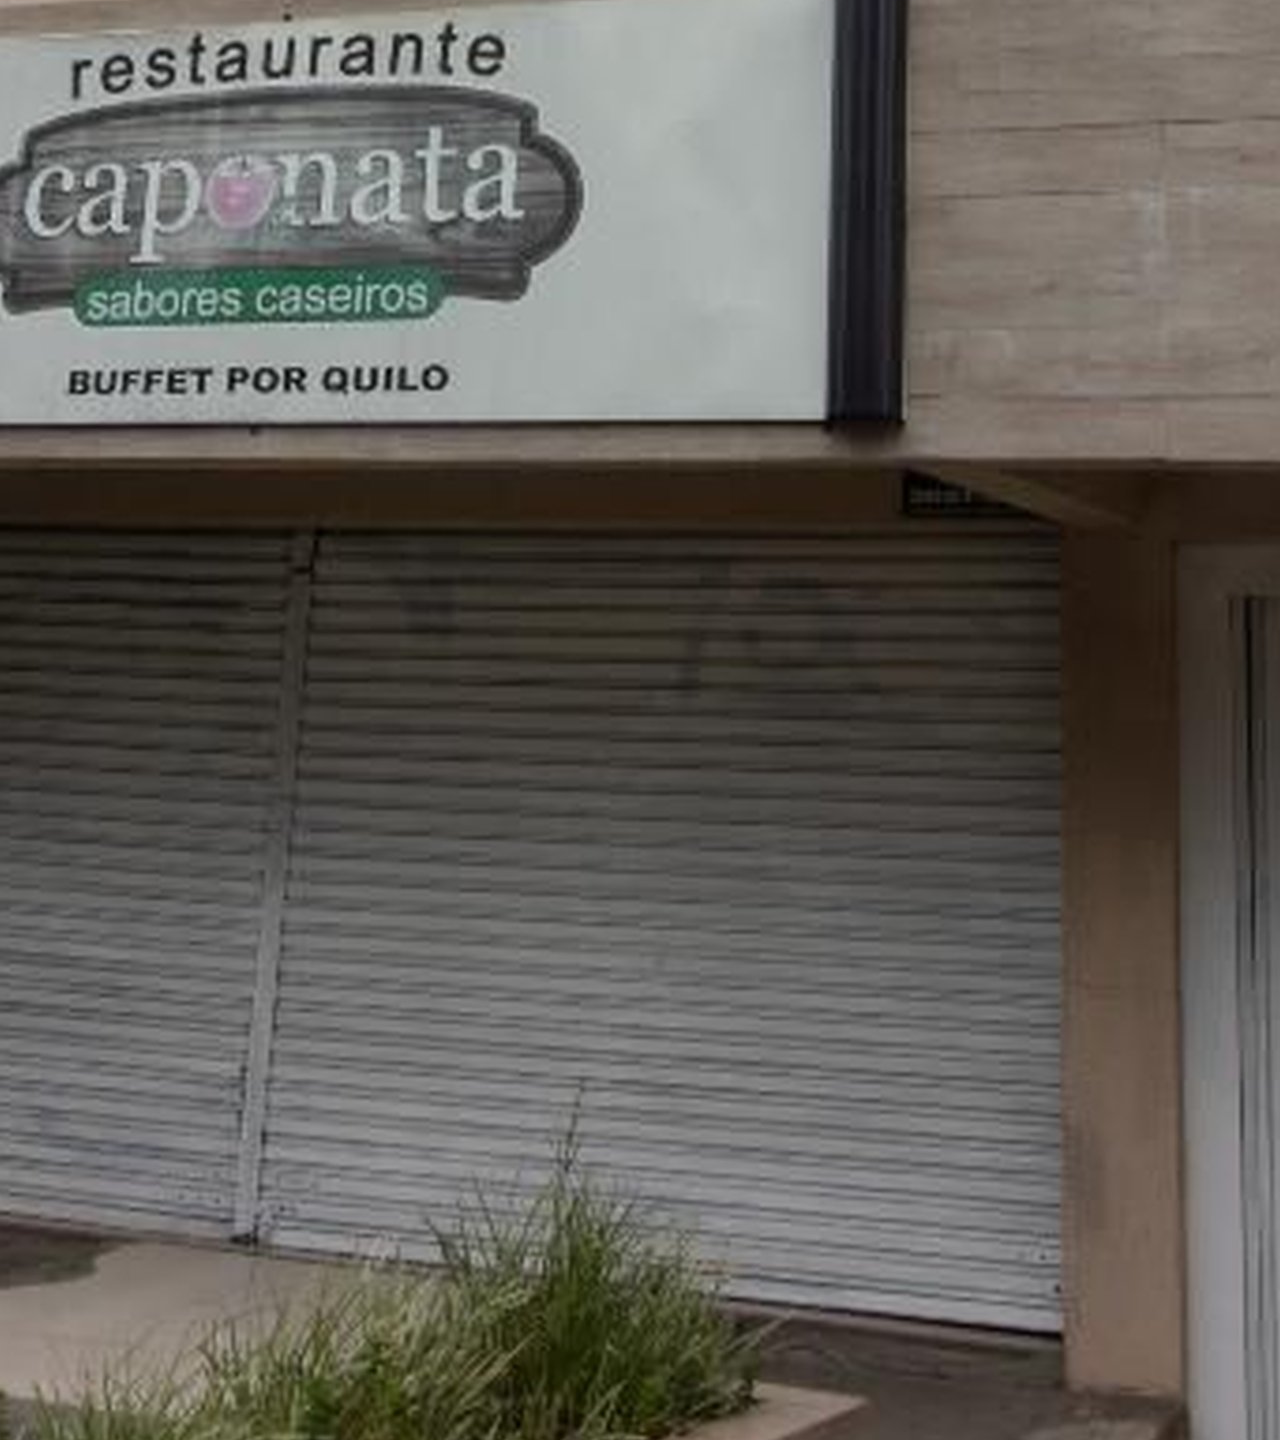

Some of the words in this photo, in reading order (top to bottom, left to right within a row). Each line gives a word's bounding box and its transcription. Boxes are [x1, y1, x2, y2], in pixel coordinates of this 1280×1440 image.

[72, 23, 507, 99] restaurante
[86, 280, 243, 321] sabores
[255, 276, 429, 316] caseiros
[68, 368, 213, 395] BUFFET
[226, 368, 308, 394] POR
[322, 364, 450, 395] QUILO
